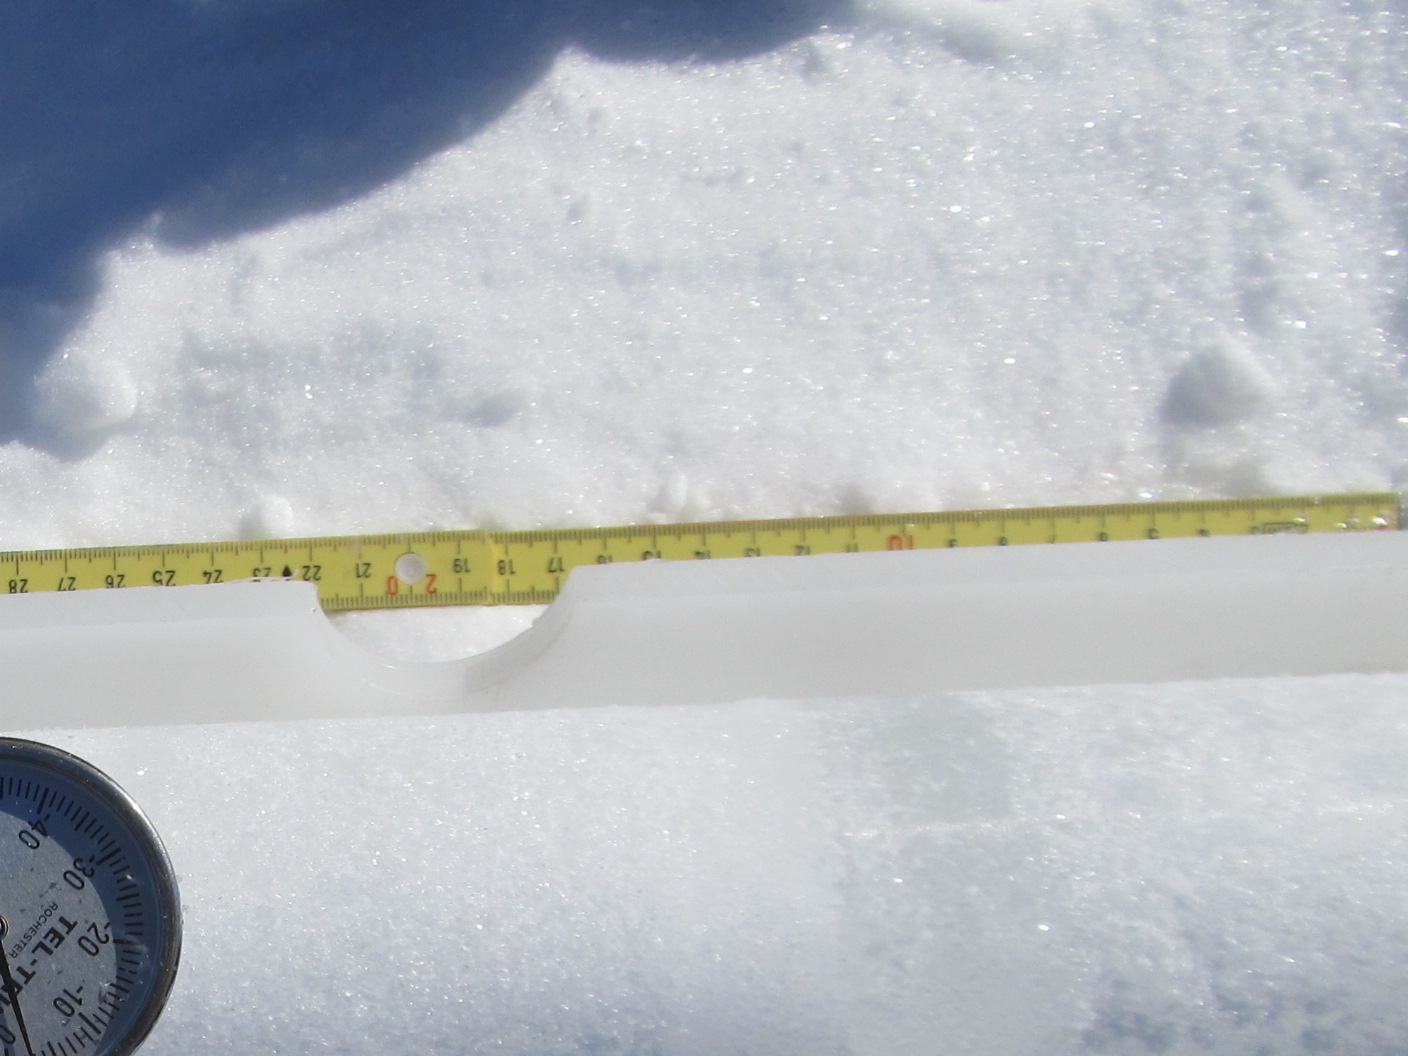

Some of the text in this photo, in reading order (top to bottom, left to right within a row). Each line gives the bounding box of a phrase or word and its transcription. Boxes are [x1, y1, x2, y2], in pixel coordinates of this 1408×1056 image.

[356, 563, 372, 578] 21
[453, 558, 471, 573] 19
[498, 560, 516, 575] 18
[547, 557, 565, 573] 17
[153, 570, 176, 586] 25
[203, 569, 223, 584] 24
[302, 565, 322, 581] 22
[9, 579, 29, 593] 28
[58, 577, 76, 592] 27
[105, 575, 126, 588] 26
[18, 813, 50, 850] -40
[63, 854, 96, 891] -30
[77, 921, 112, 957] -20
[53, 985, 84, 1018] -10
